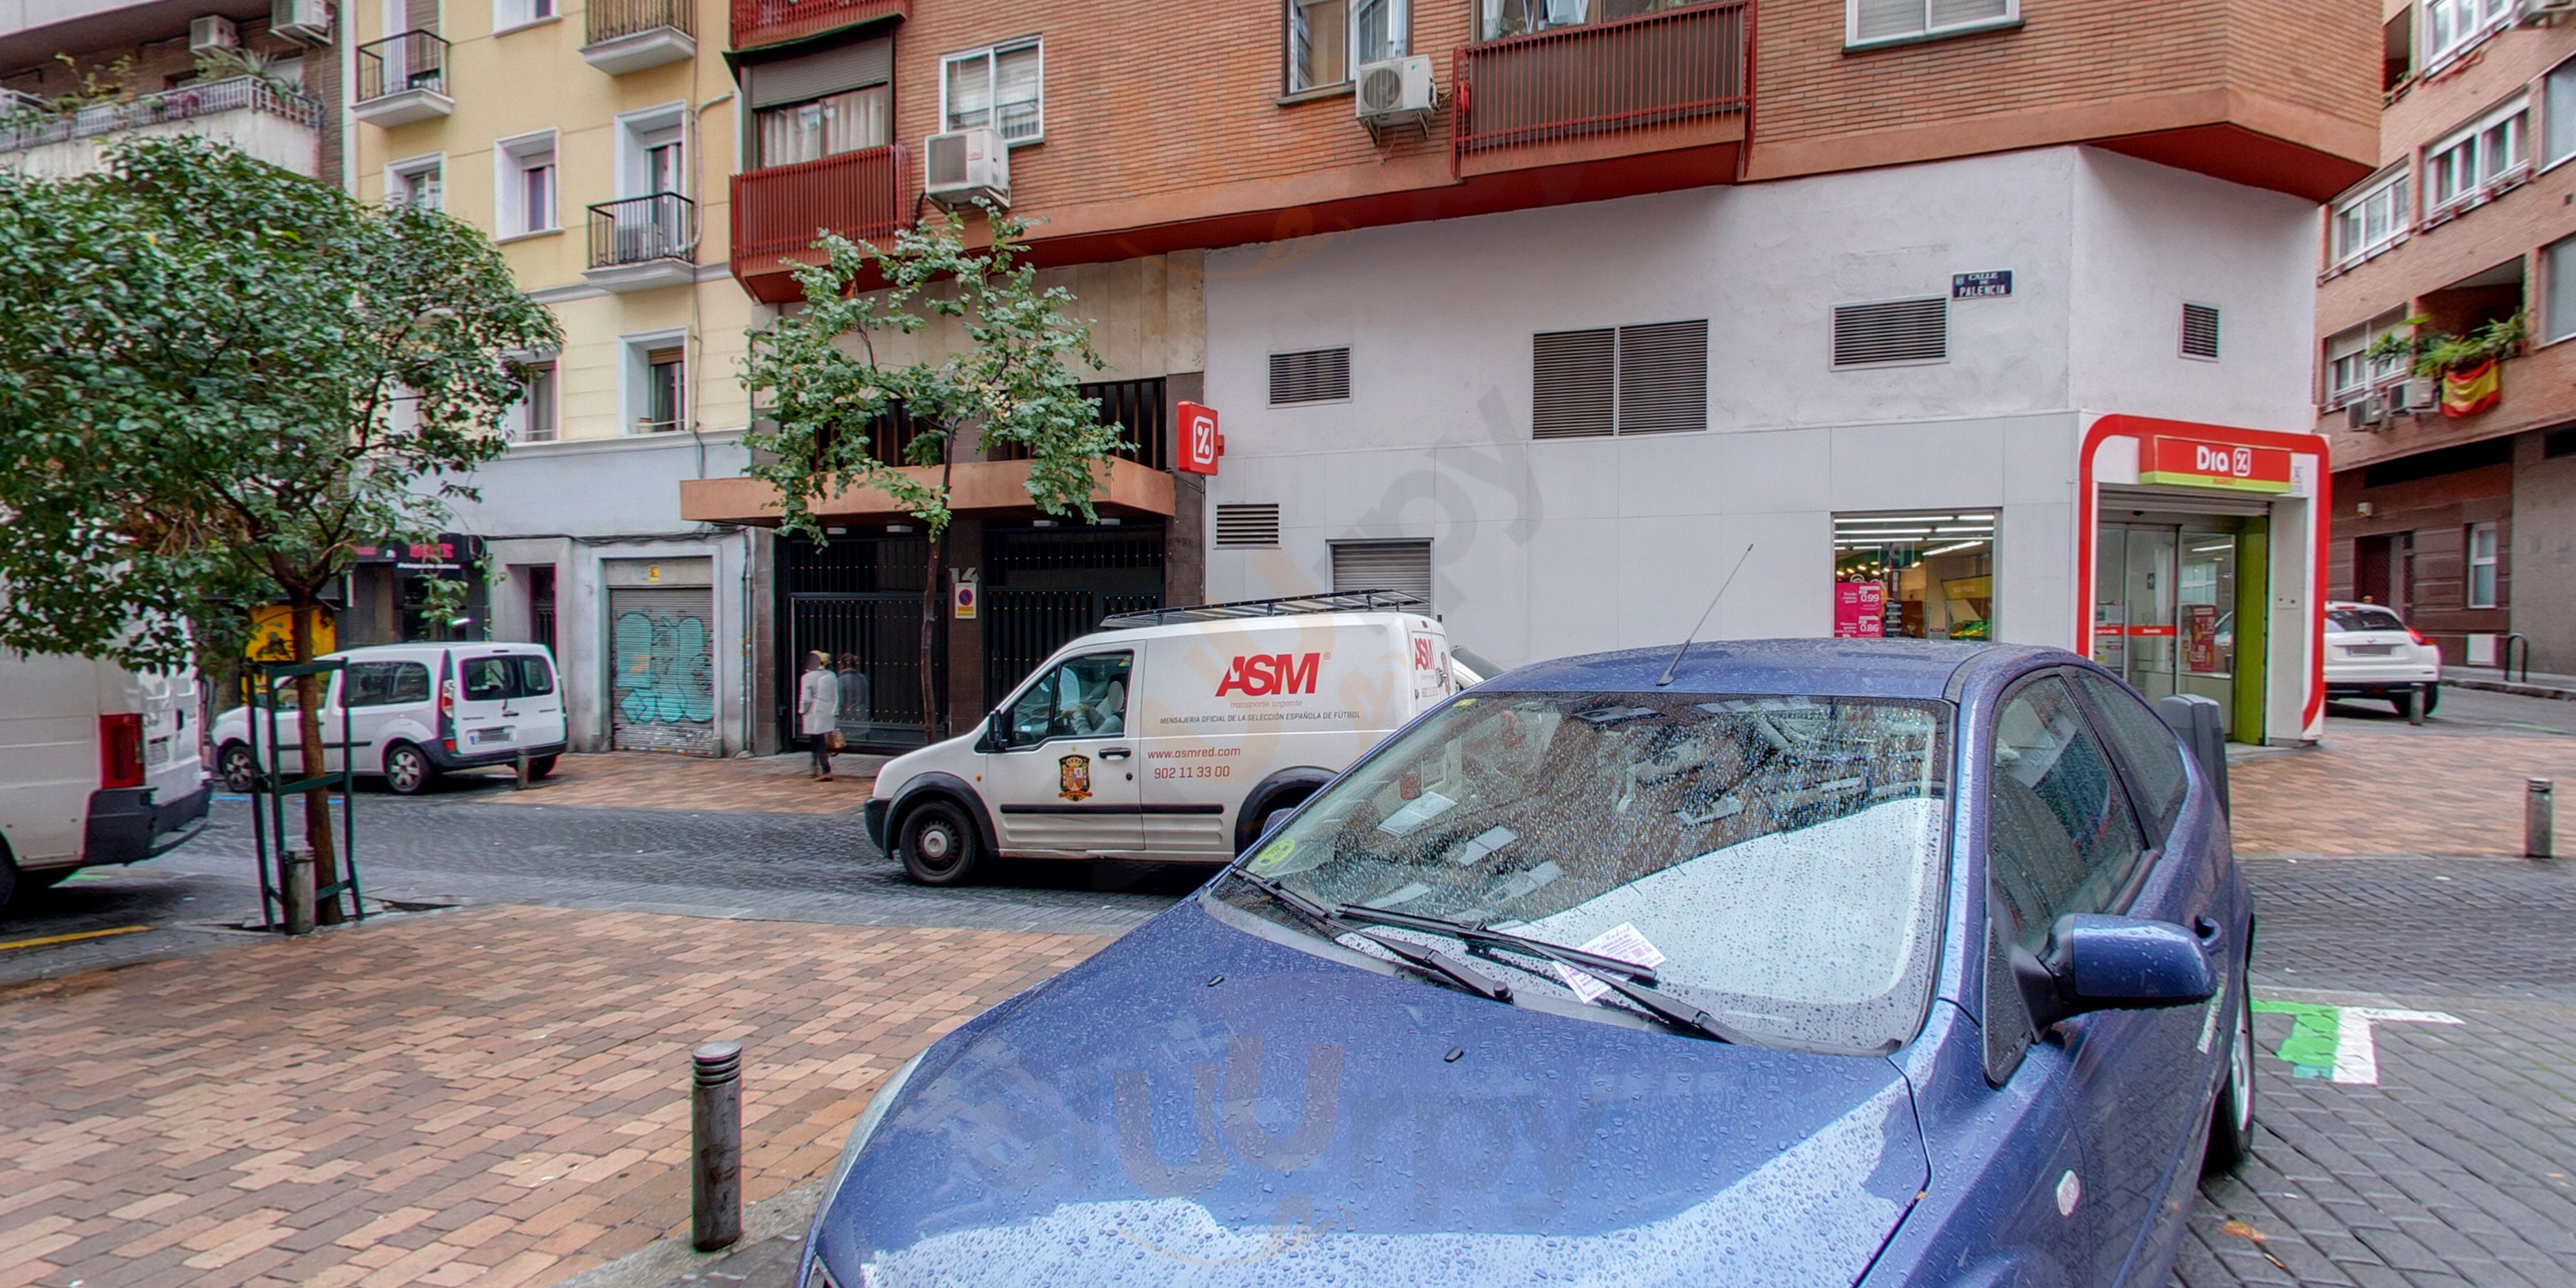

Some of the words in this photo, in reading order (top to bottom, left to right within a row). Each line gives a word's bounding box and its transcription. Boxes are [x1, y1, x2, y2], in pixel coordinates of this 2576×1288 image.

[1968, 272, 1998, 281] CALLE
[1959, 284, 2006, 297] PALENCIA
[2196, 445, 2229, 473] Dia
[949, 567, 980, 583] 14
[1414, 638, 1435, 671] ASM
[1215, 652, 1320, 697] ASM
[1230, 700, 1270, 709] transporte
[1271, 699, 1303, 708] urgente
[1247, 712, 1284, 721] SELECCIÓN
[1286, 711, 1321, 720] ESPAÑOLA
[1334, 710, 1361, 719] FÚTBOL
[1148, 747, 1241, 759] www.asmred.com
[1154, 767, 1176, 779] 902
[1179, 767, 1193, 778] 11
[1196, 766, 1211, 778] 33
[1215, 765, 1230, 777] 00
